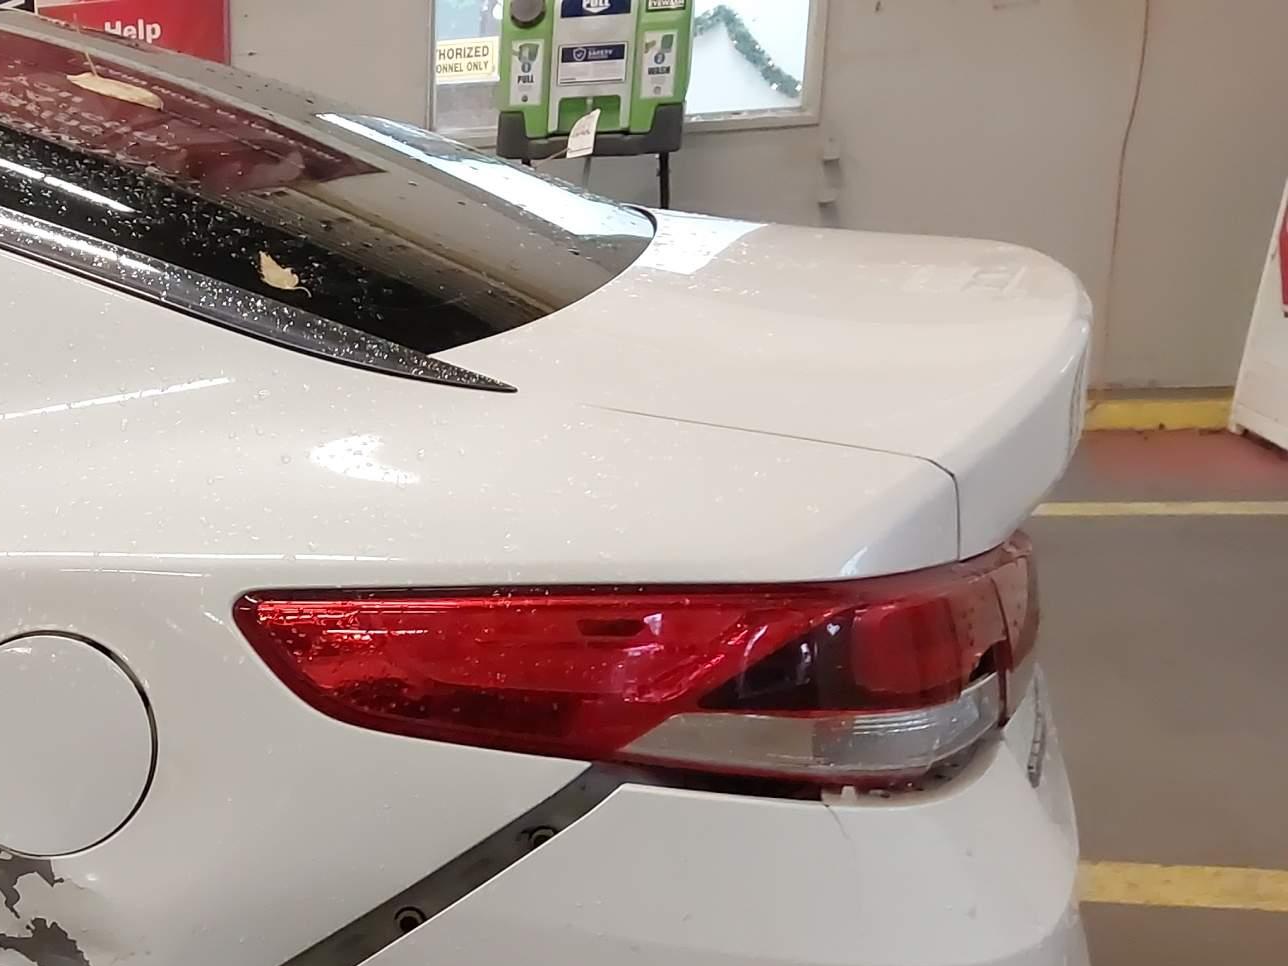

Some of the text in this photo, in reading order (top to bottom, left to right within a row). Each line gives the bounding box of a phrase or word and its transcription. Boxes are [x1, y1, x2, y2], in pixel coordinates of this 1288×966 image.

[104, 18, 162, 43] Help
[436, 45, 489, 60] HORIZED
[466, 60, 489, 72] ONLY
